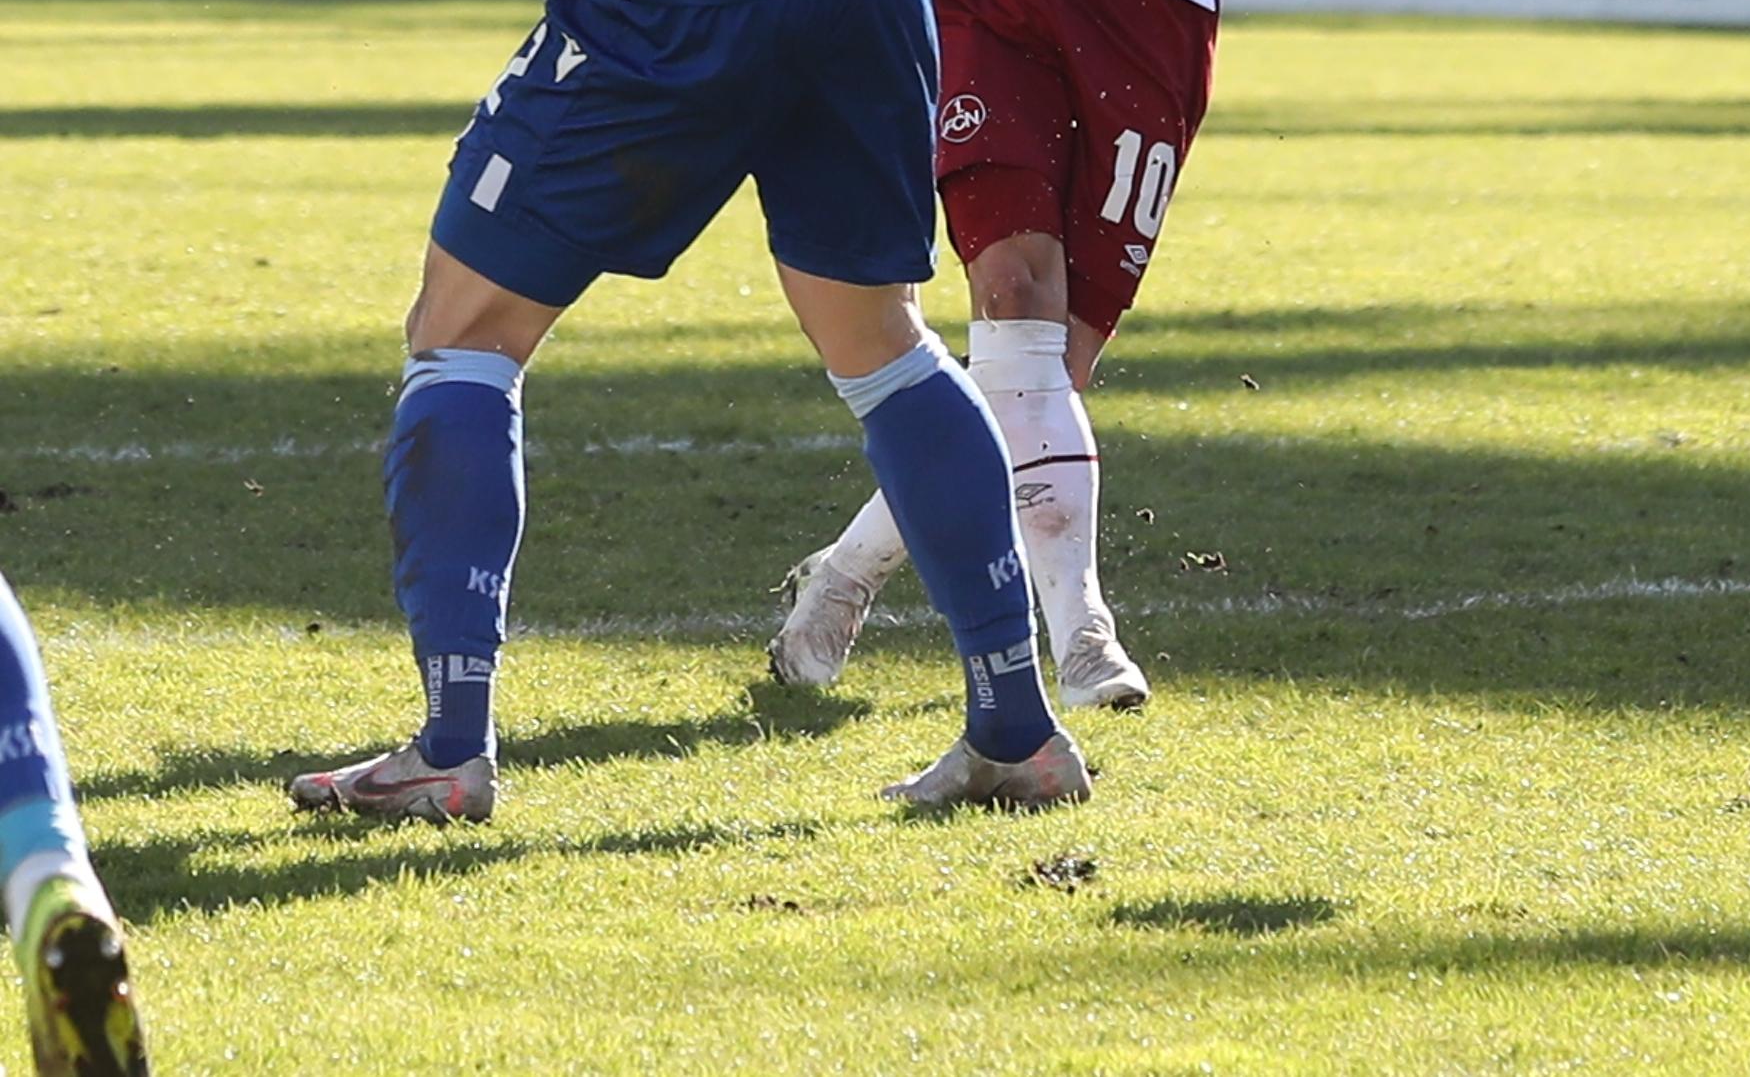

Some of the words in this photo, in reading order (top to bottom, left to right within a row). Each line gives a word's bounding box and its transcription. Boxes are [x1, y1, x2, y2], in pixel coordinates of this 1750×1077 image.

[1100, 128, 1176, 241] 10
[467, 566, 500, 599] KS
[987, 549, 1019, 590] KS
